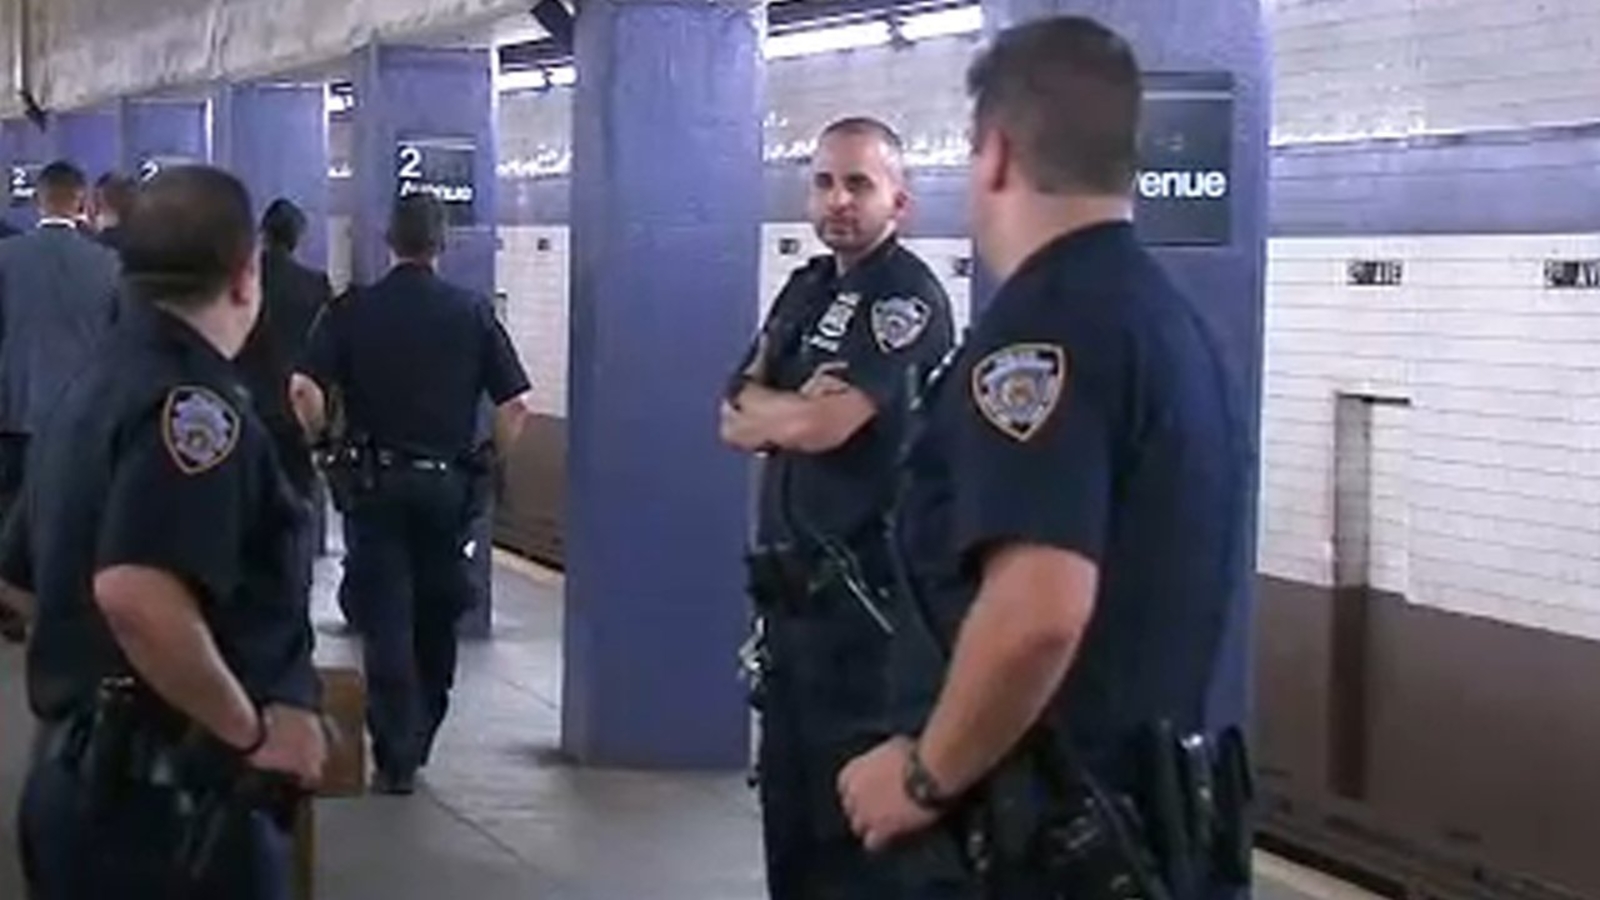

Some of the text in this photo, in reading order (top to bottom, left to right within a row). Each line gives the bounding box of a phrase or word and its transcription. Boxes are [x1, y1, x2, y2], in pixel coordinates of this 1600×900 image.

[399, 147, 421, 177] 2
[12, 167, 26, 185] 2
[1133, 170, 1227, 197] enue
